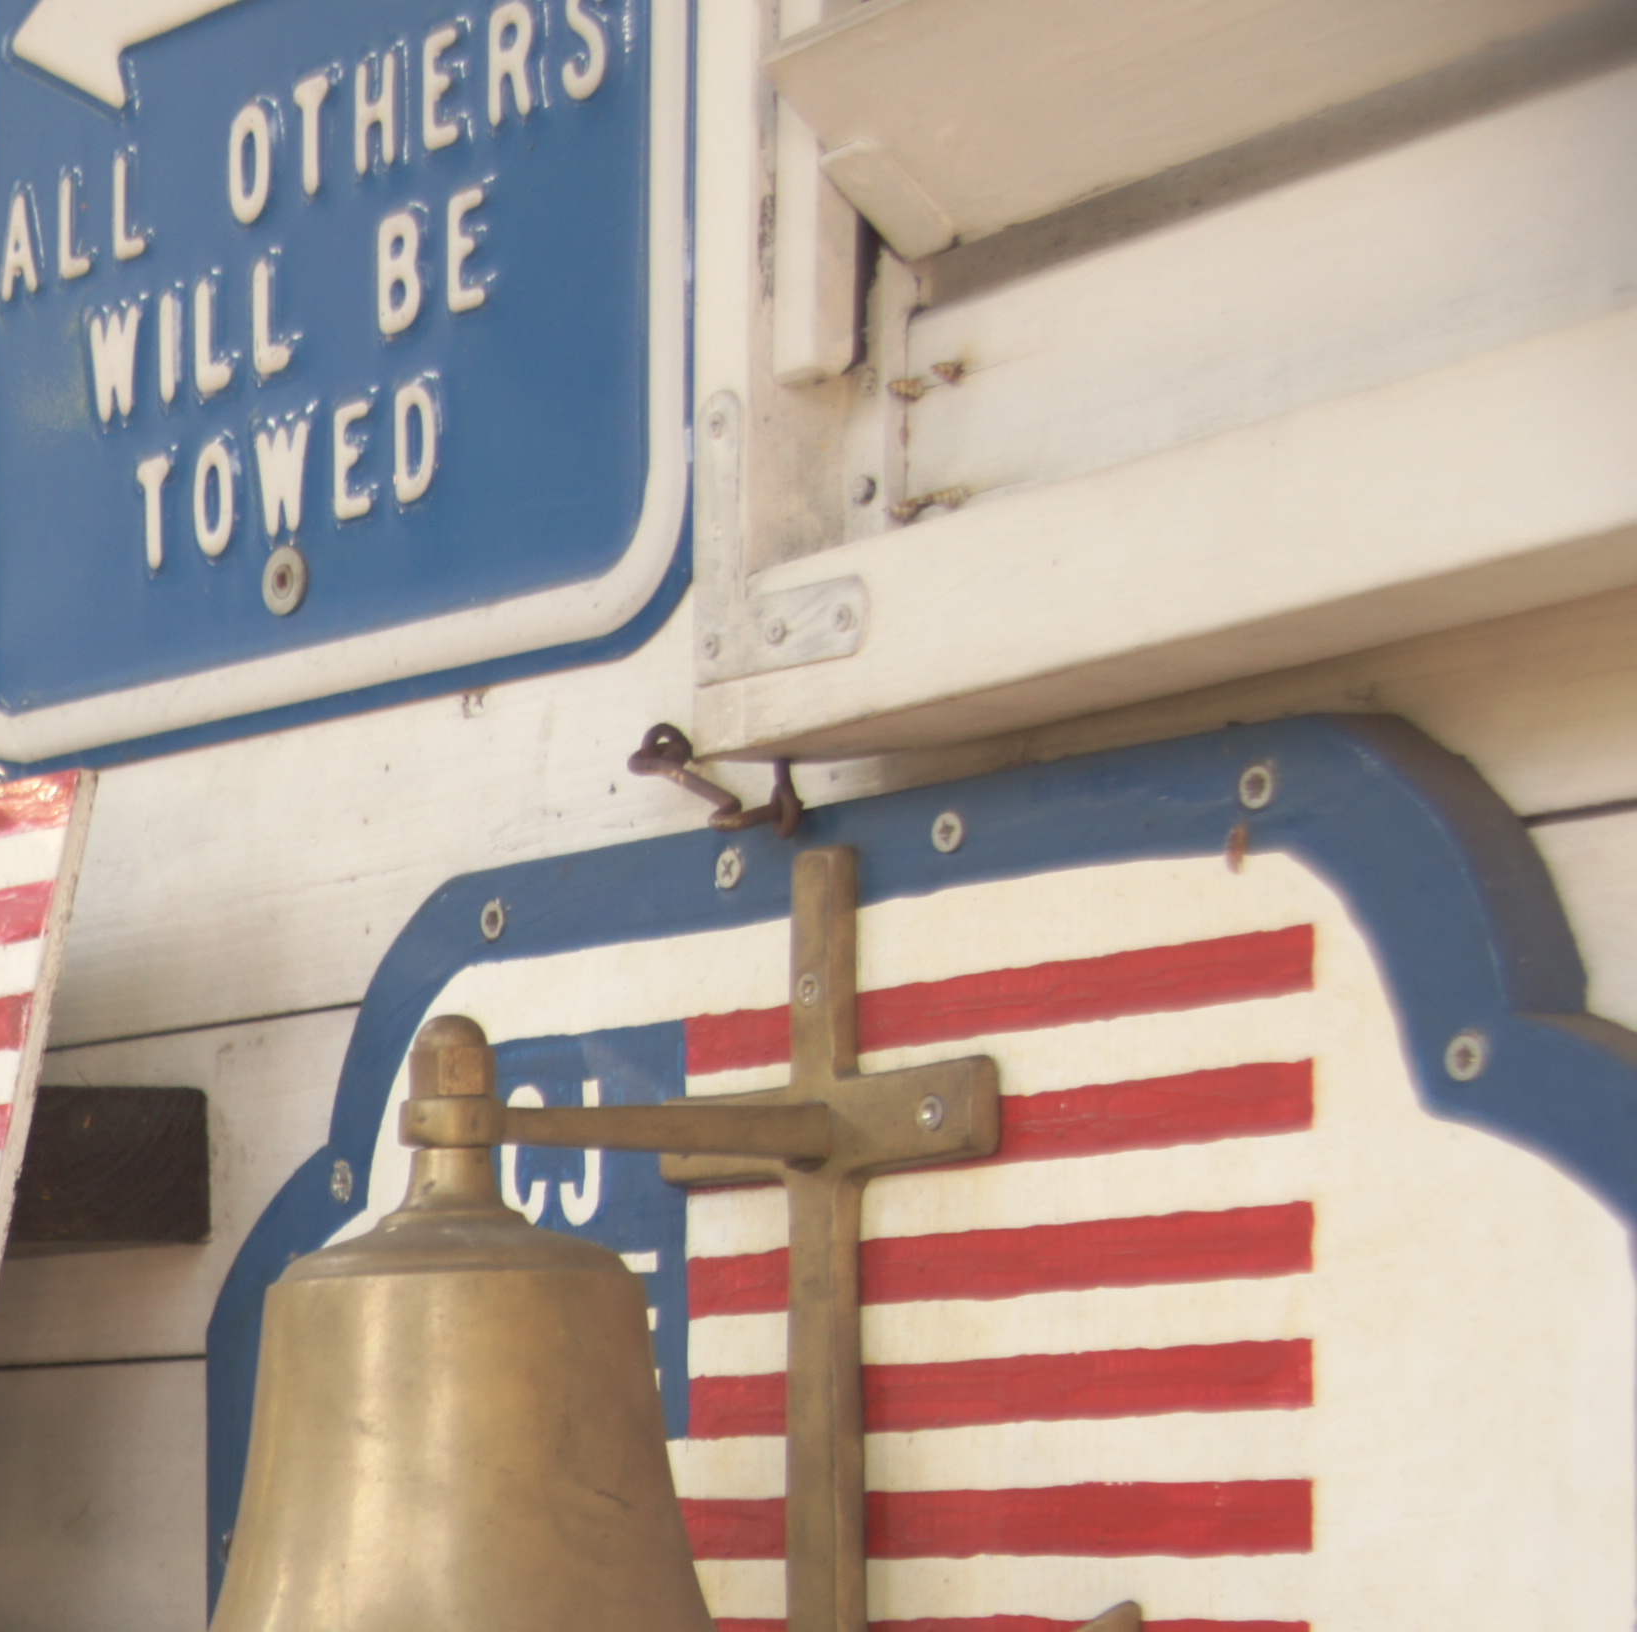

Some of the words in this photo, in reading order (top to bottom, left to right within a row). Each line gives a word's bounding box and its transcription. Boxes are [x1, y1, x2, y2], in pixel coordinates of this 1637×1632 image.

[0, 152, 148, 303] ALL
[228, 0, 609, 225] OTHERS
[89, 257, 293, 425] WILL
[377, 187, 489, 337] BE
[136, 382, 438, 570] TOWED
